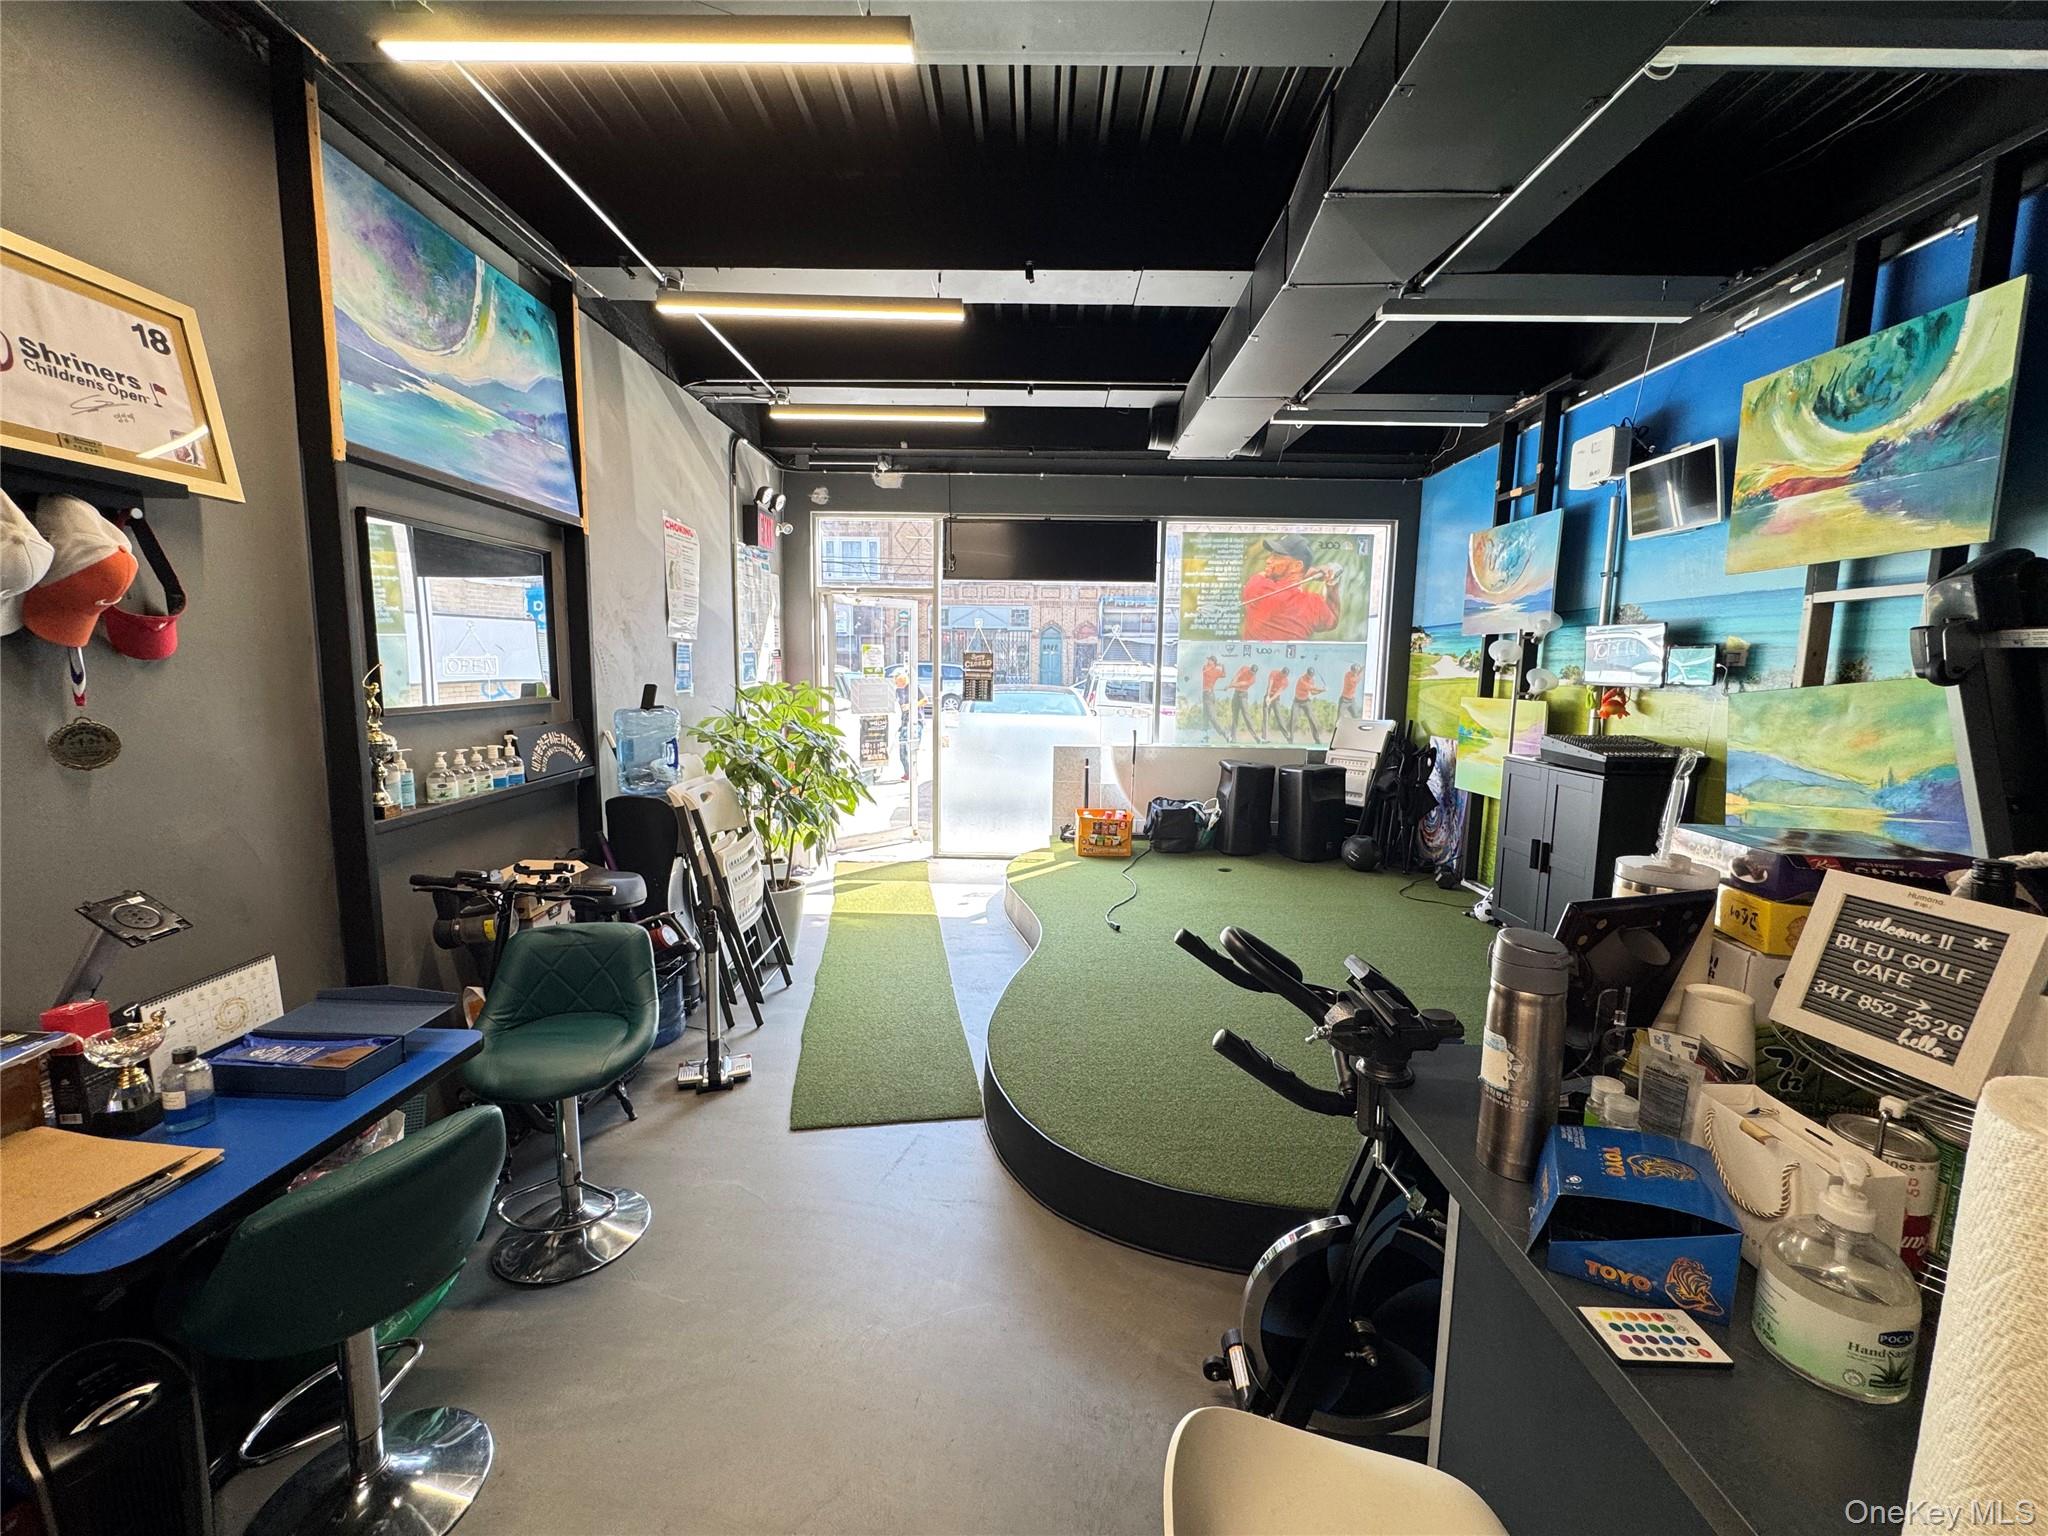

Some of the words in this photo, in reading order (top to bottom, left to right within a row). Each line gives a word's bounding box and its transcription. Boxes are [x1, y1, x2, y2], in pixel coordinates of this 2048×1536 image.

[131, 322, 171, 355] 18
[18, 335, 142, 391] Shriners
[24, 360, 104, 391] Children's
[108, 382, 148, 404] Open
[664, 519, 694, 538] CHOKING
[447, 659, 497, 673] OPEN
[965, 660, 992, 668] CLOSED
[1855, 917, 1933, 945] welcome
[1835, 933, 1895, 962] BLEU
[1902, 953, 1975, 985] GOLF
[1852, 959, 1914, 989] CAFE
[1813, 979, 1853, 1002] 347
[1857, 995, 1898, 1019] 852
[1904, 1010, 1966, 1042] 2526
[1896, 1028, 1948, 1058] hello
[1601, 1146, 1626, 1177] TOYO
[1584, 1259, 1653, 1292] TOYO
[1848, 1342, 1887, 1358] Hand
